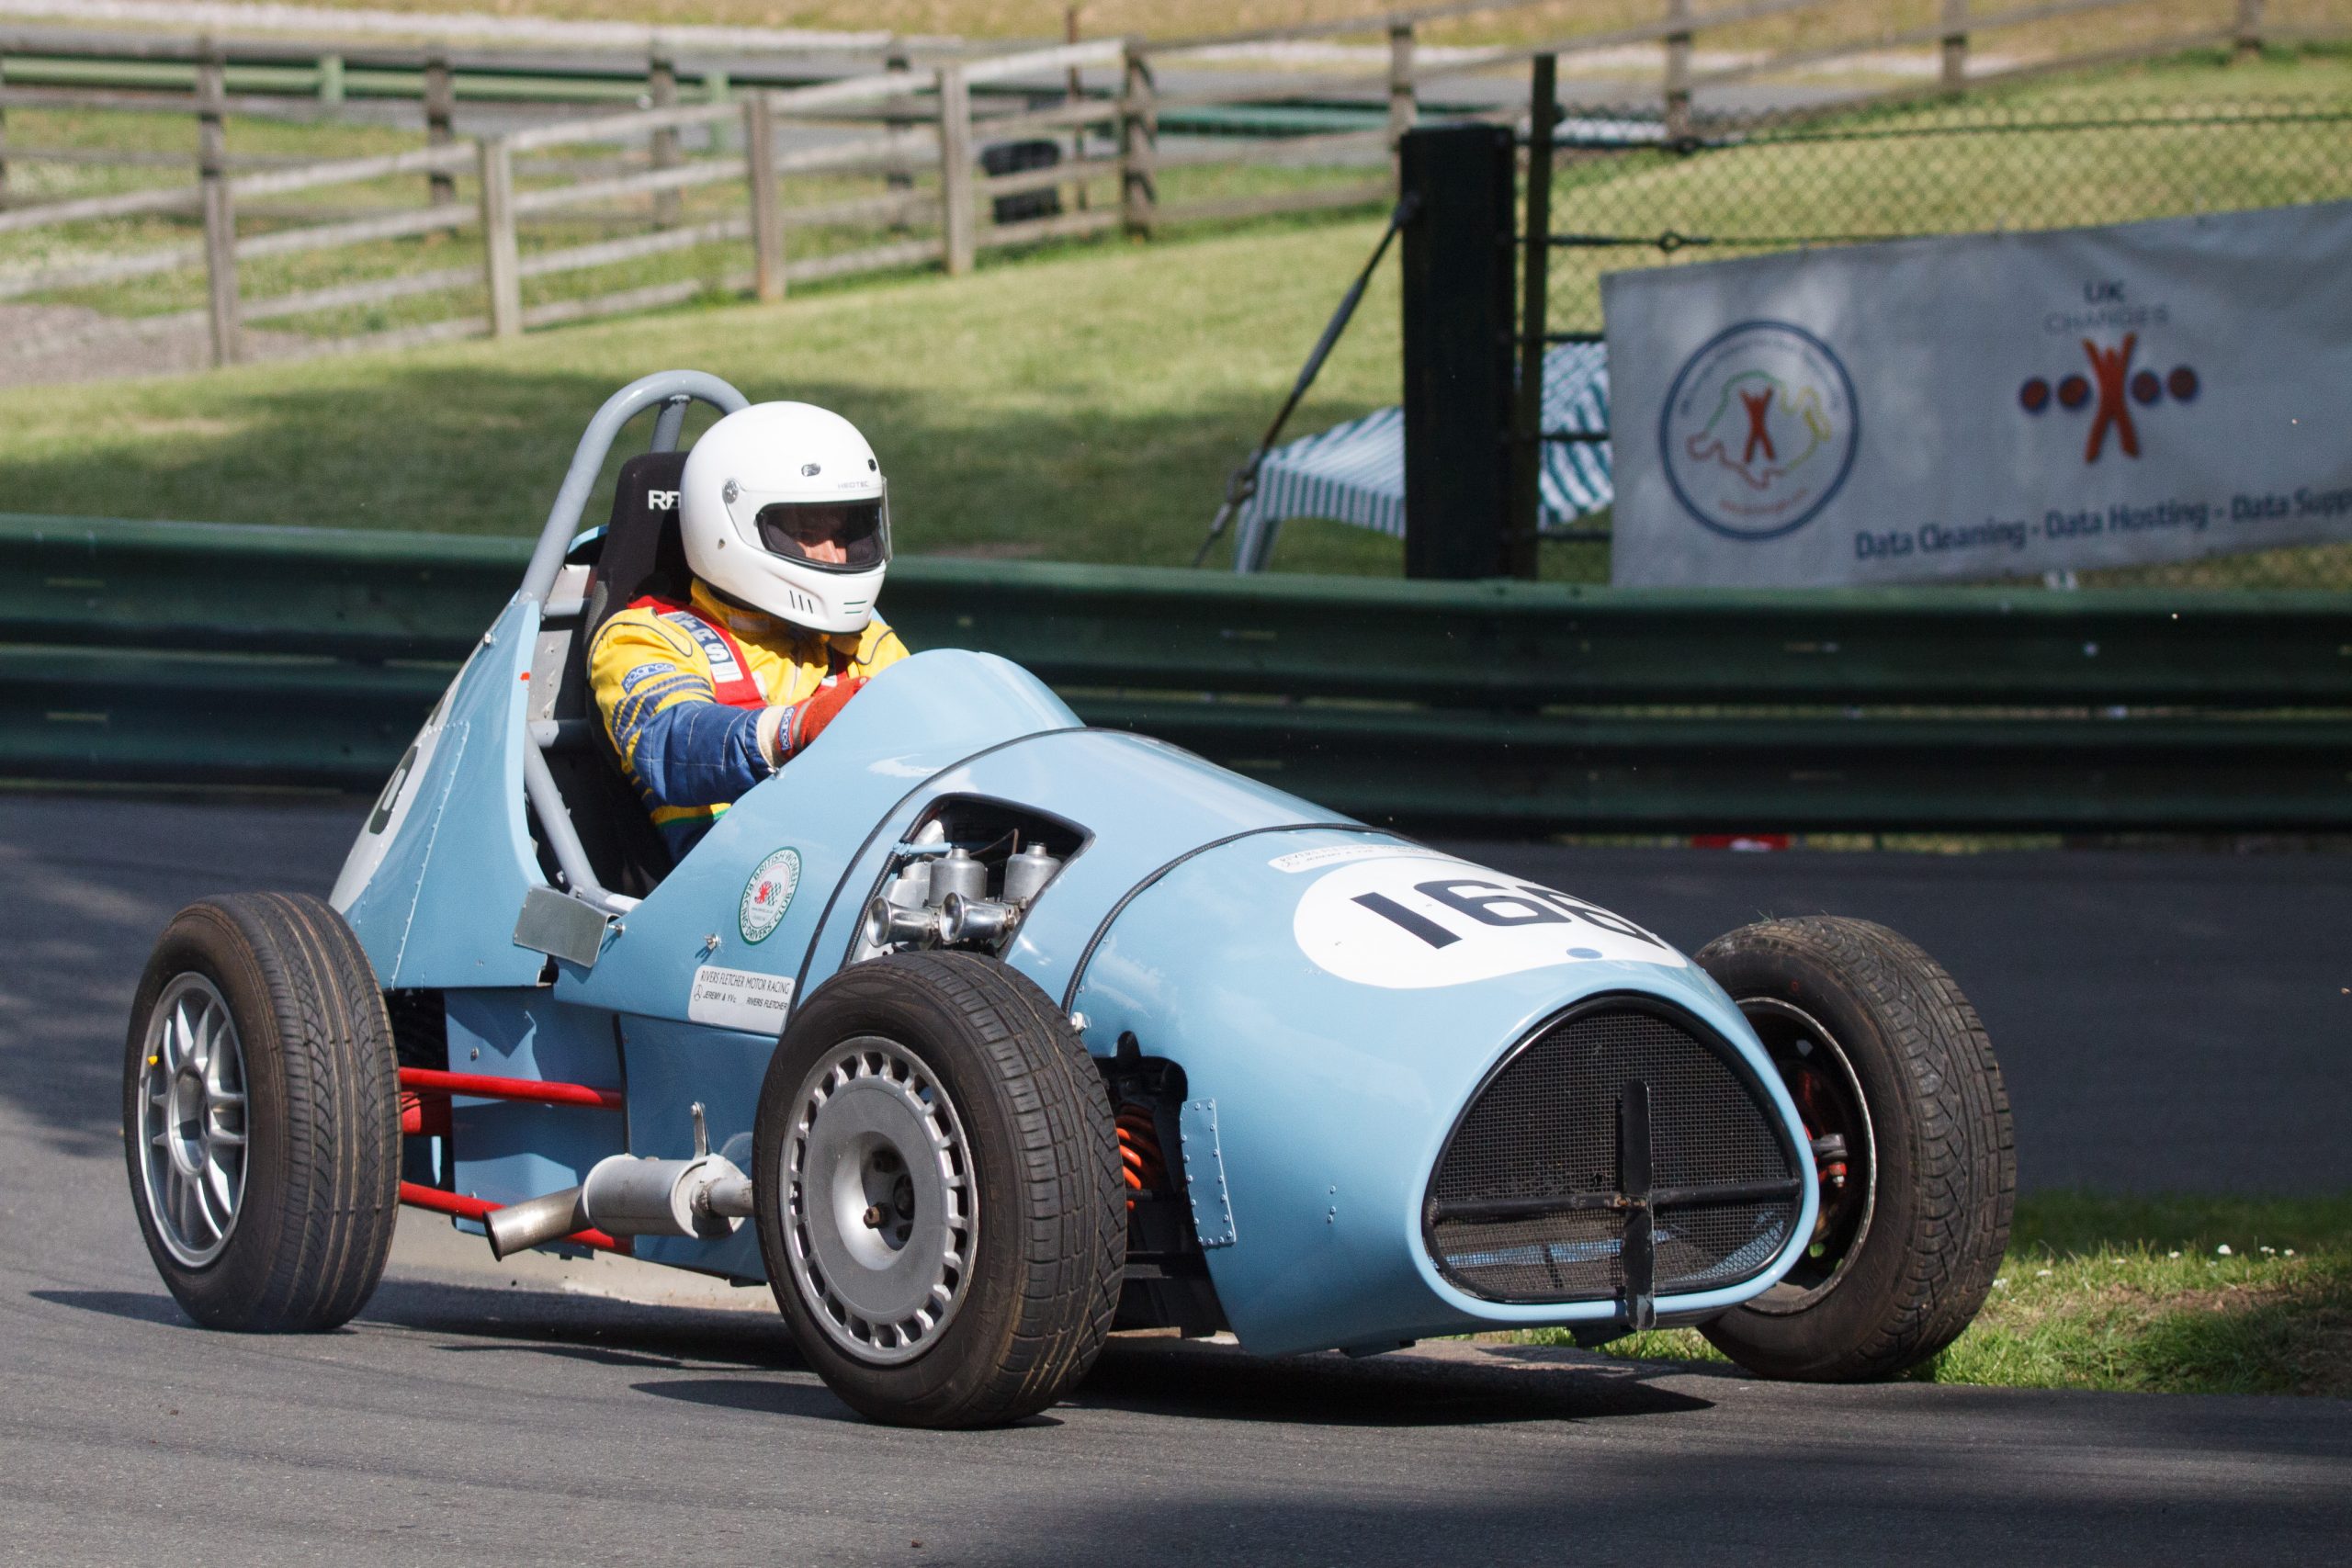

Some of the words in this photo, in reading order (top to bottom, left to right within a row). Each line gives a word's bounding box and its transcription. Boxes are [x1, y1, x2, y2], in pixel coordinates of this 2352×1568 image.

[1855, 528, 1914, 559] Data
[1918, 517, 2027, 552] Cleaning
[2044, 508, 2104, 540] Data
[2108, 499, 2209, 533] Hosting
[2230, 491, 2290, 524] Data
[753, 851, 786, 881] BRITISH
[741, 883, 754, 929] RACING
[774, 892, 794, 923] CLUB
[744, 925, 773, 940] DRIVERS
[701, 970, 718, 984] RIVERS
[719, 973, 745, 988] FLETCHER
[746, 977, 766, 991] MOTOR
[767, 980, 791, 995] RACING
[702, 990, 721, 1000] JEREMY
[746, 996, 764, 1008] RIVERS
[764, 998, 789, 1010] FLETCHER
